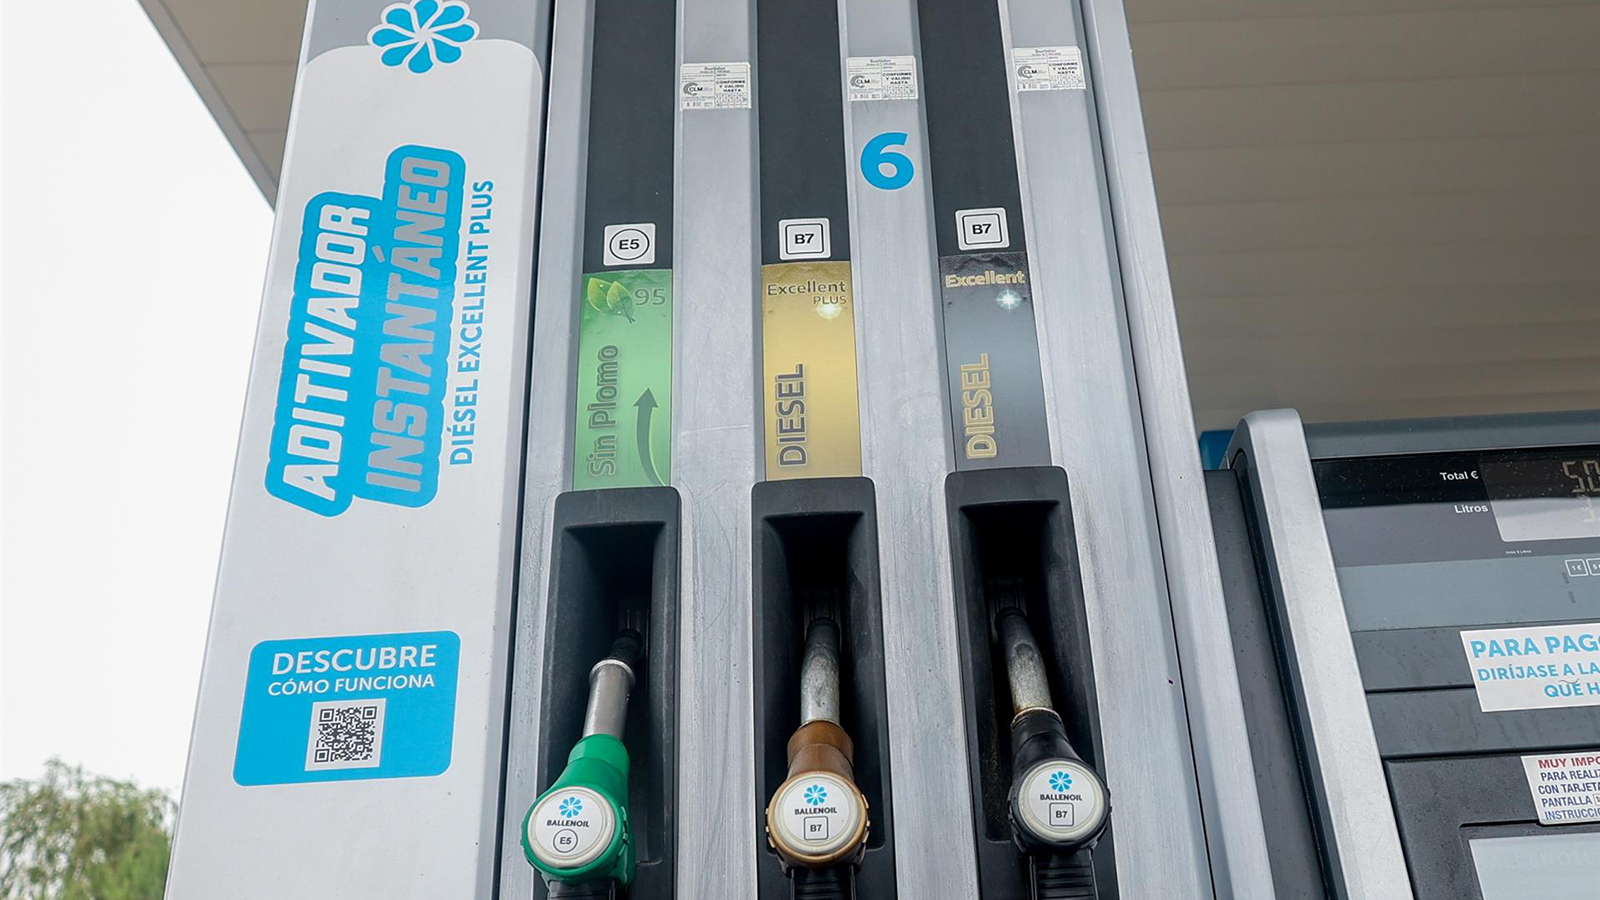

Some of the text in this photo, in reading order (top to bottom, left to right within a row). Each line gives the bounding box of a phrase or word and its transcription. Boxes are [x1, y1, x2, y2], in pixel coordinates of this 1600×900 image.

[860, 131, 915, 191] 6
[972, 223, 992, 235] B7
[618, 239, 640, 250] E5
[794, 233, 815, 245] B7
[945, 270, 1026, 288] Excellent
[767, 280, 847, 296] Excellent
[634, 288, 667, 306] 95
[812, 295, 848, 305] PLUS
[366, 156, 450, 493] INSTANTÁNEO
[446, 179, 494, 466] DIÉSEL EXCELLENT PLUS
[283, 204, 370, 501] ADITIVADOR
[587, 344, 620, 478] Sin Plomo
[960, 353, 998, 460] DIESEL
[775, 363, 808, 467] DIESEL
[1440, 470, 1479, 481] Total €
[1454, 504, 1489, 514] Litros
[1470, 634, 1600, 658] PARA PAG
[271, 644, 437, 675] DESCUBRE
[1477, 664, 1559, 681] DIRÍJASE
[1563, 663, 1575, 676] A
[268, 673, 435, 696] CÓMO FUNCIONA
[1538, 758, 1567, 769] MUY
[1540, 771, 1568, 781] PARA
[1538, 784, 1560, 795] CON
[1040, 794, 1083, 802] BALLENOIL
[1542, 795, 1593, 808] PANTALLA
[794, 807, 838, 816] BALLENOIL
[1055, 810, 1068, 819] B7
[546, 819, 590, 828] BALLENOIL
[810, 824, 823, 833] B7
[559, 836, 572, 845] E5
